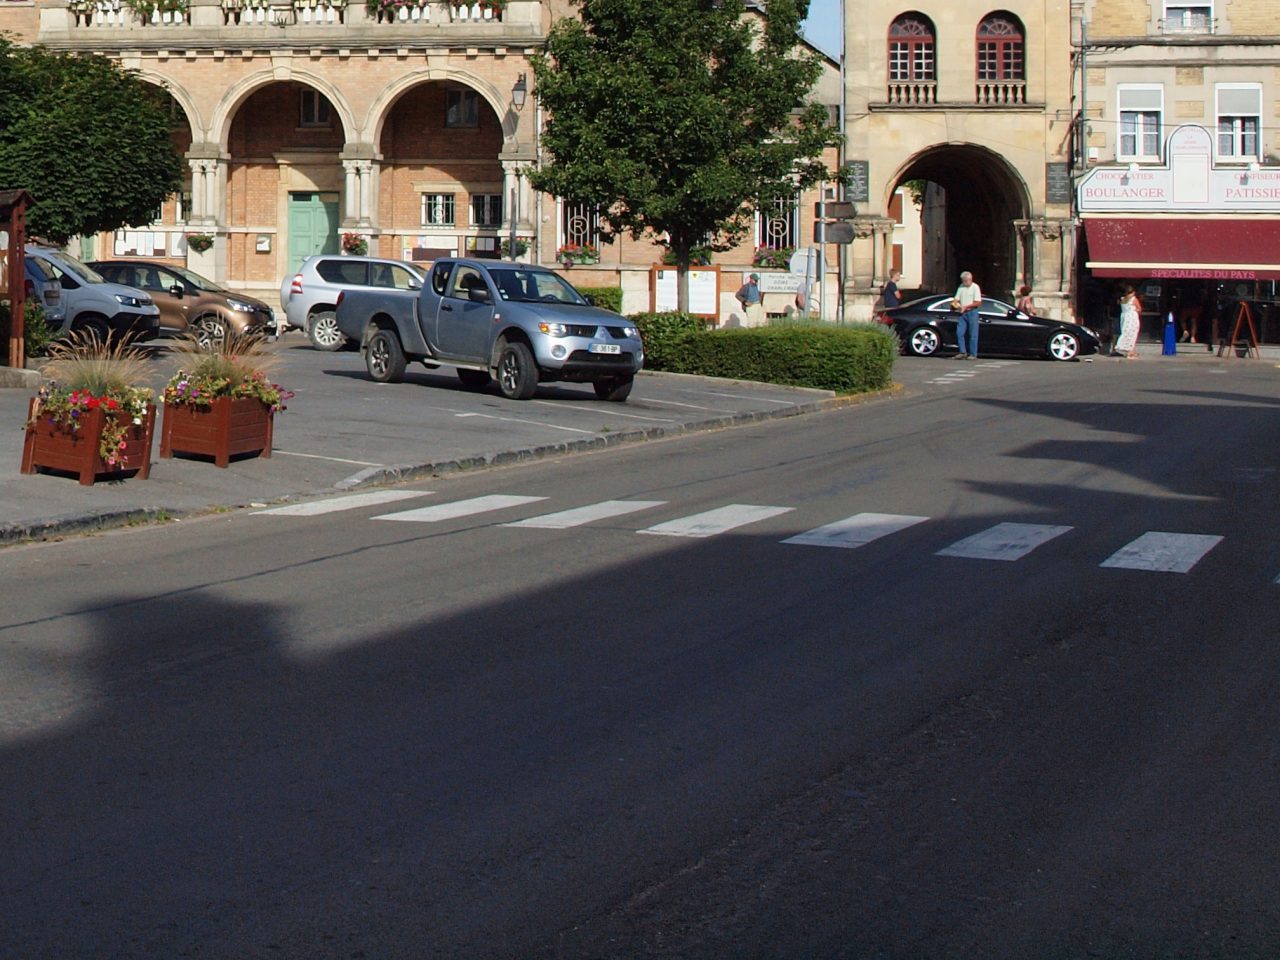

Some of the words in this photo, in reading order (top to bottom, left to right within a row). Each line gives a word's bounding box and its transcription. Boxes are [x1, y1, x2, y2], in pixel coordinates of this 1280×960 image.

[1086, 187, 1165, 198] BOULANGER
[1151, 270, 1211, 278] SPECIALITES
[1214, 271, 1228, 279] DU
[1231, 271, 1255, 279] PAYS
